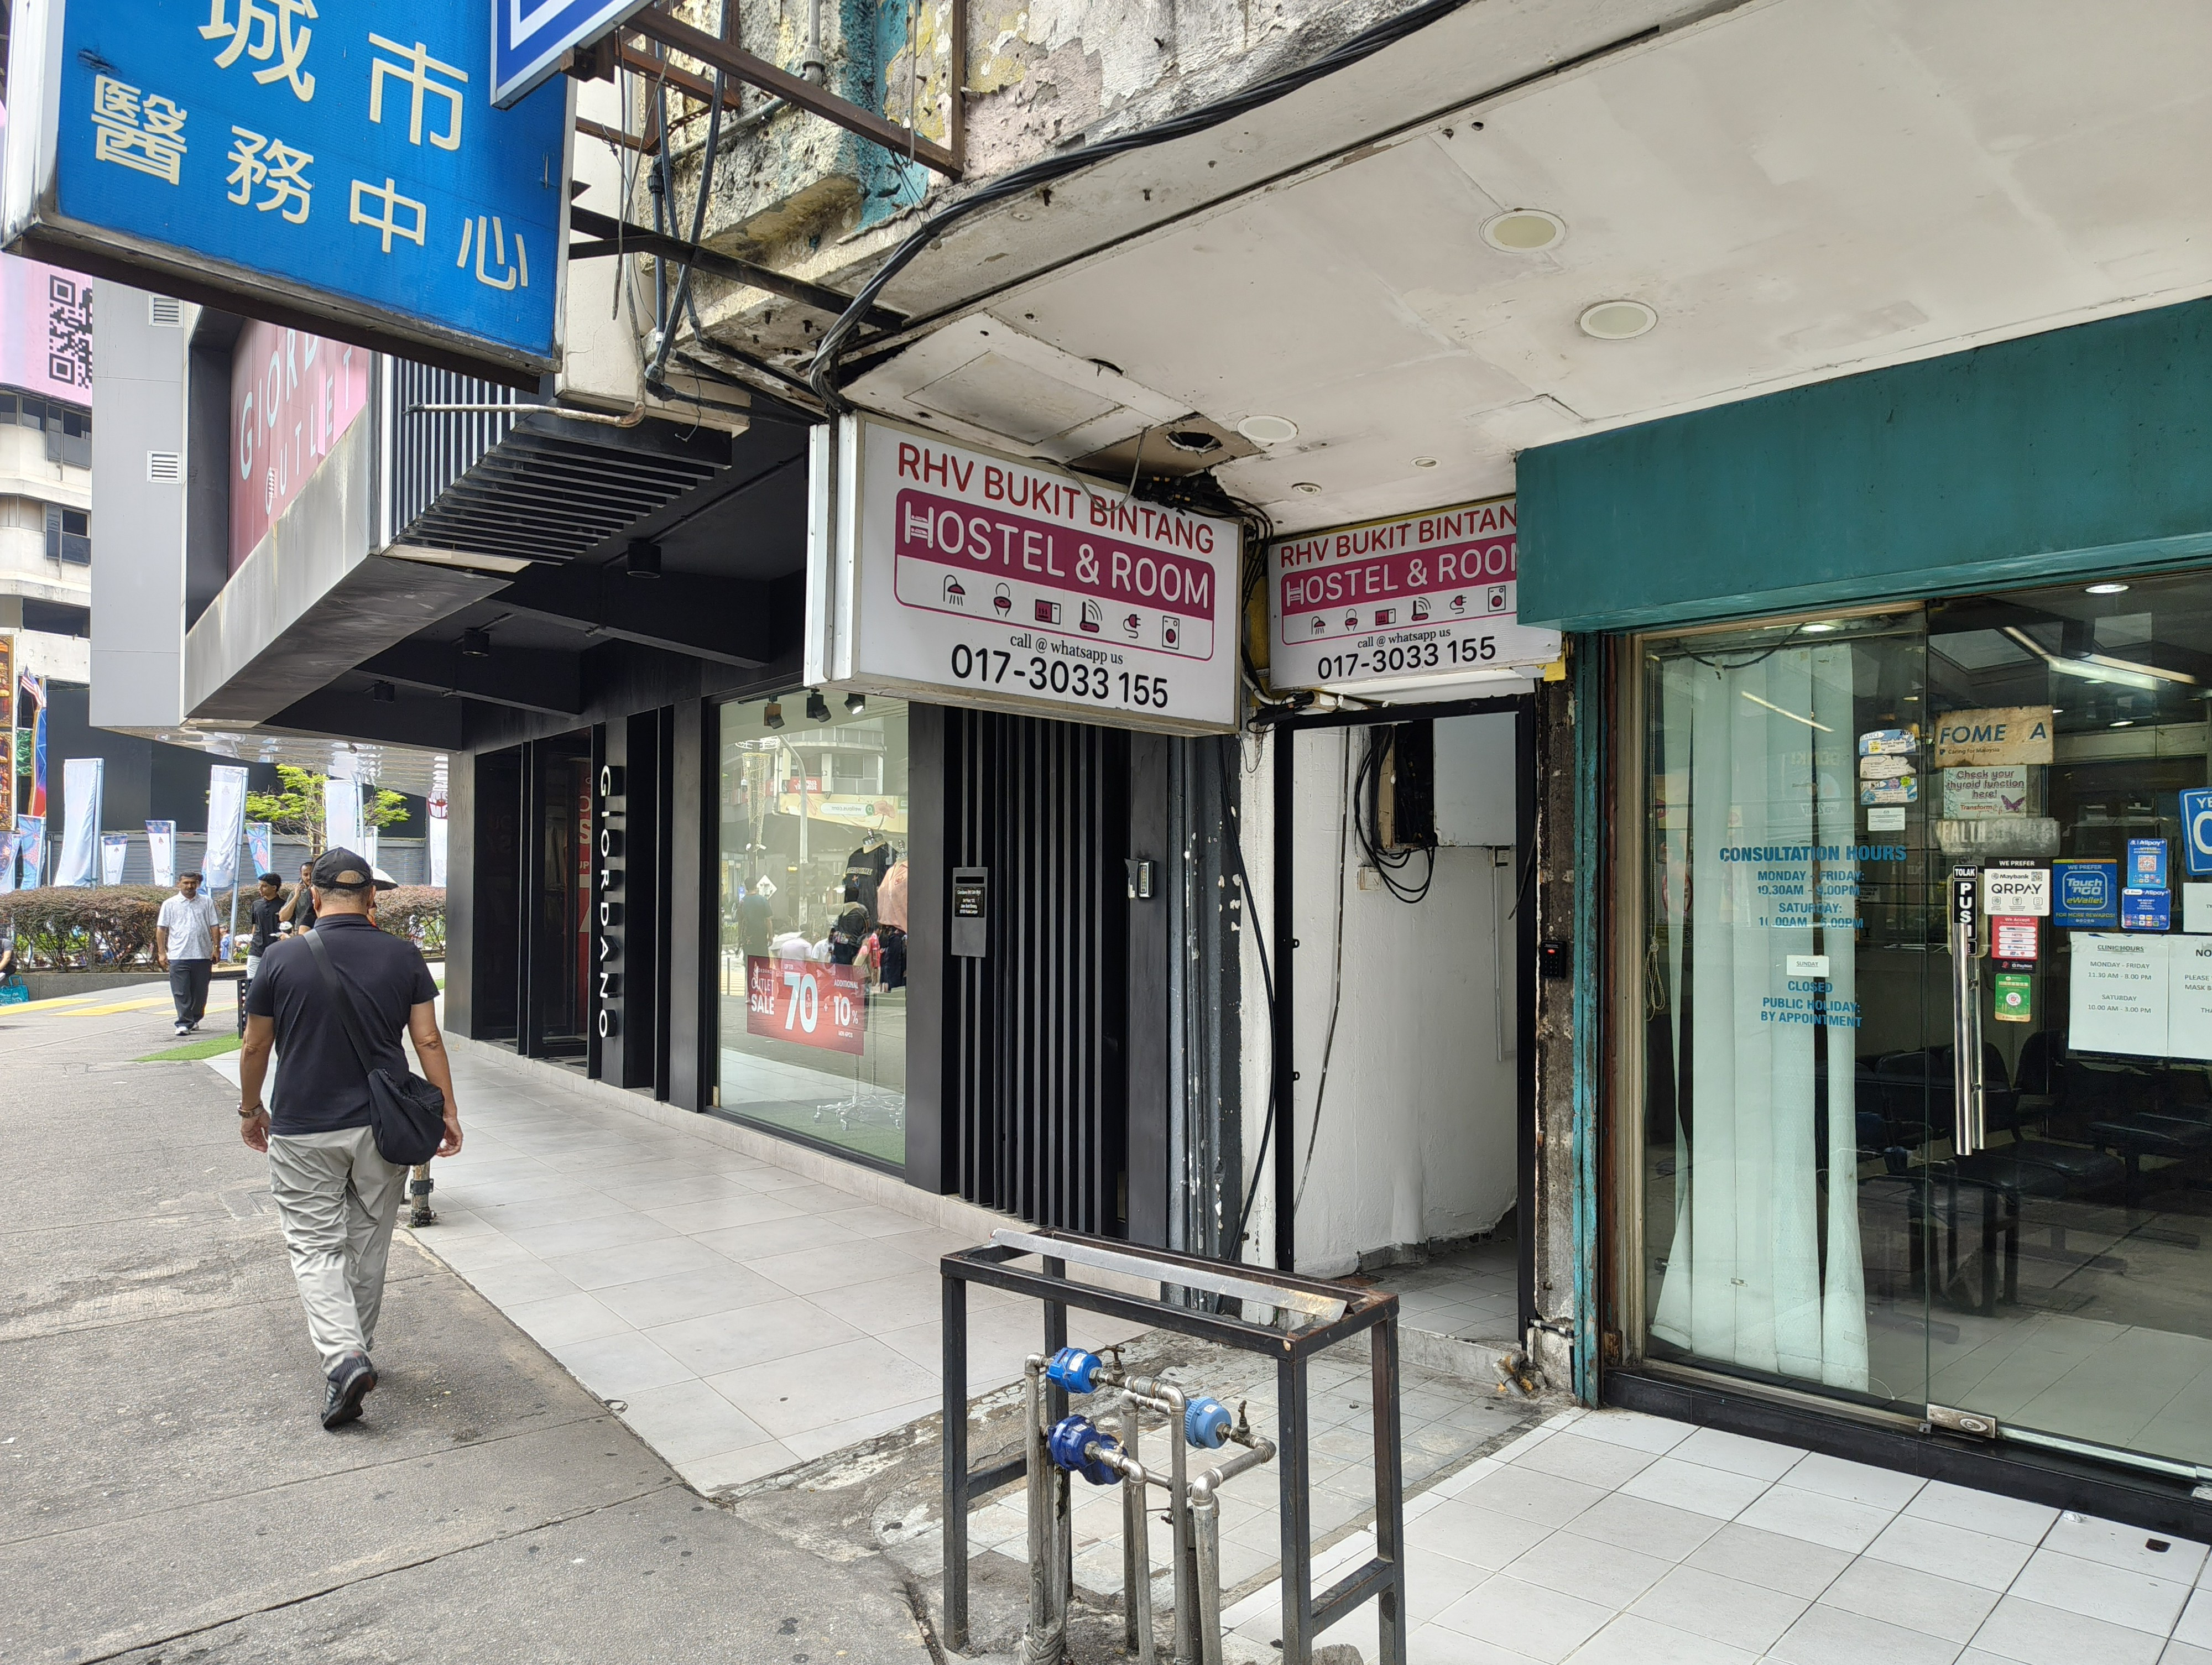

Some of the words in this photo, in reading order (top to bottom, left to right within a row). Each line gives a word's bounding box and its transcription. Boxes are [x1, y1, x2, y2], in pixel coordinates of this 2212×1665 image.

[198, 0, 468, 151] 城市
[91, 74, 528, 291] 醫務中心
[899, 442, 974, 492] RHV
[984, 466, 1081, 519] BUKIT
[1091, 497, 1214, 554] BINTANG
[1281, 538, 1329, 568] RHV
[1336, 523, 1411, 557] BUKIT
[905, 501, 1065, 577] HOSTEL
[1076, 543, 1099, 585] &
[1111, 551, 1208, 609] ROOM
[1286, 565, 1398, 607] HOSTEL
[1407, 559, 1428, 587] &
[1358, 636, 1374, 649] call
[1376, 636, 1386, 647] @
[1388, 631, 1436, 644] whatsapp
[1439, 629, 1451, 637] us
[1010, 633, 1031, 649] call
[1035, 638, 1047, 654] @
[1051, 640, 1107, 665] whatsapp
[1110, 653, 1123, 665] us
[1318, 643, 1439, 680] 017-3033
[1447, 636, 1496, 664] 155
[951, 644, 1109, 700] 017-3033
[1119, 672, 1168, 708] 155
[1957, 769, 1988, 779] Check
[1992, 770, 2015, 780] your
[1947, 780, 1981, 791] thyroid
[1984, 779, 2024, 789] function
[1973, 790, 1997, 798] here!
[1720, 846, 1839, 862] CONSULTATION
[1846, 845, 1907, 861] HOURS
[1757, 870, 1807, 881] MONDAY
[1819, 870, 1865, 881] FRIDAY:
[2066, 878, 2103, 887] Touch
[1991, 884, 2042, 894] QRPAY
[599, 765, 611, 1038] GIORDANO
[1779, 902, 1841, 914] SATURDAY:
[751, 977, 774, 991] OUTLET
[833, 979, 858, 989] ADDITIONAL
[1788, 980, 1833, 993] CLOSED
[751, 993, 774, 1015] SALE
[784, 972, 818, 1033] 70
[1763, 997, 1803, 1009] PUBLIC
[1807, 1000, 1860, 1013] HOLIDAY:
[1761, 1011, 1776, 1021] BY
[1779, 1012, 1863, 1027] APPOINTMENT
